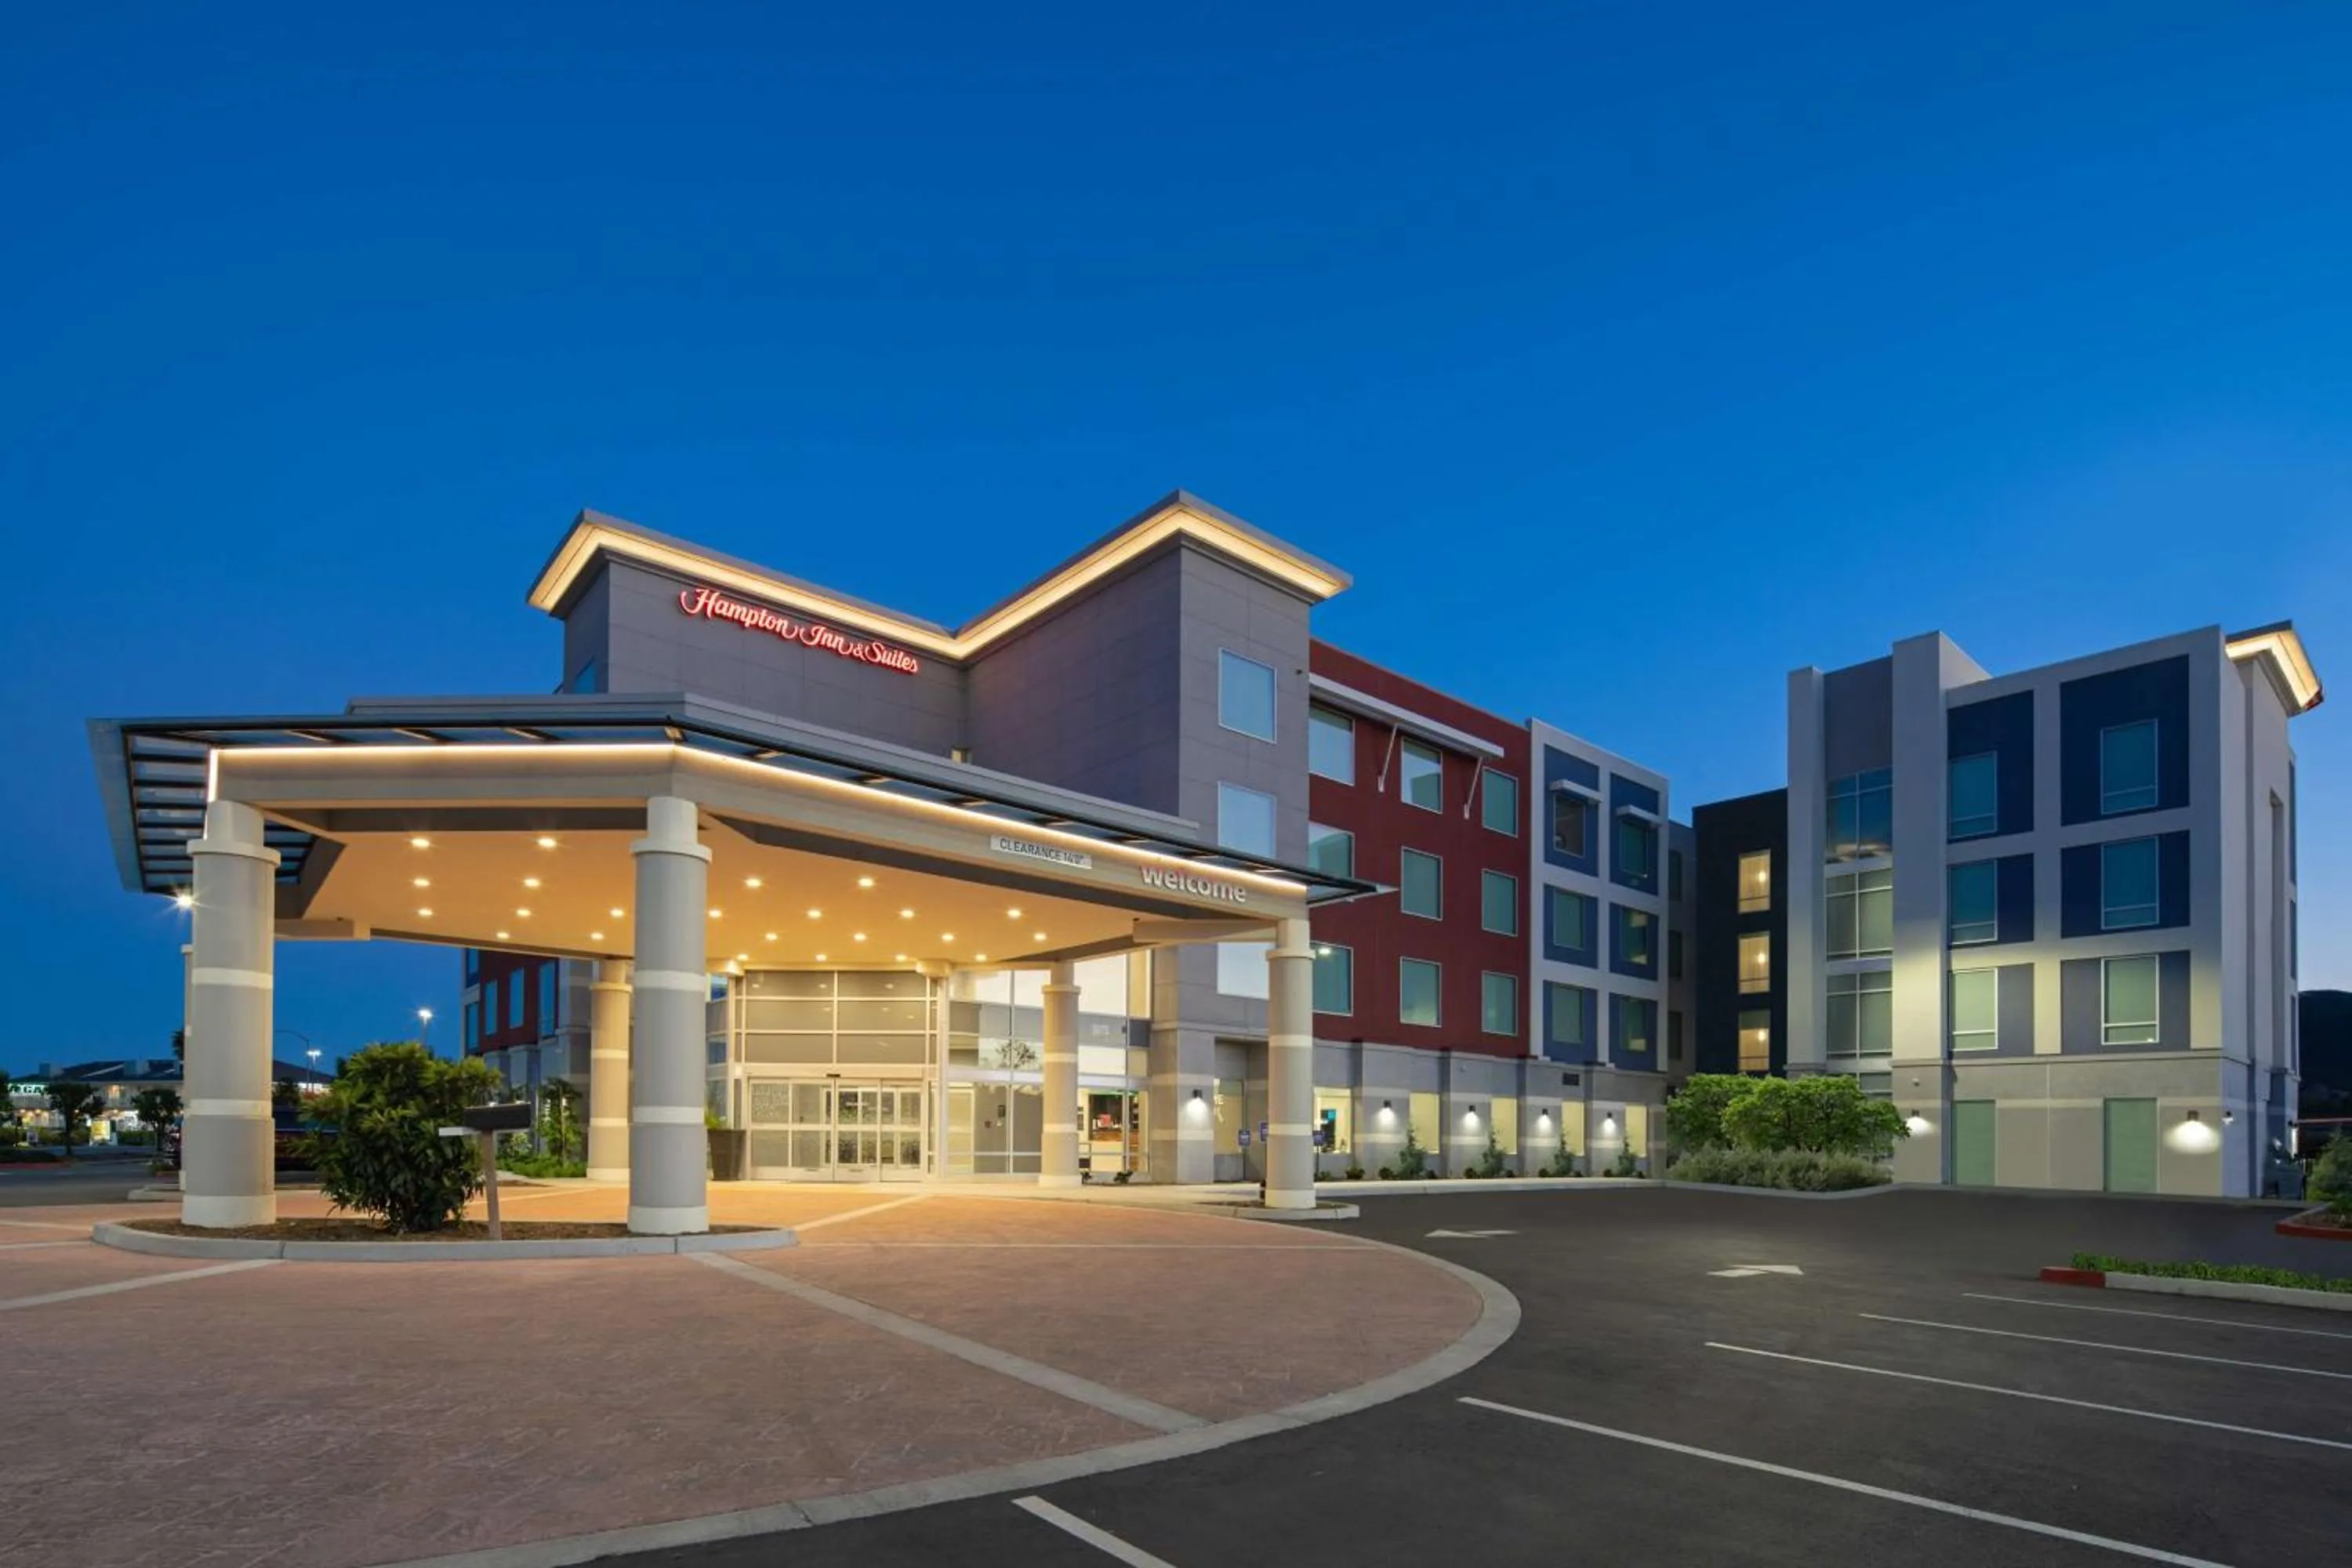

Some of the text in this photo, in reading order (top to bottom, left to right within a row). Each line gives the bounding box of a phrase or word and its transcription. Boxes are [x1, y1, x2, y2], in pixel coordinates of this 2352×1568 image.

[681, 588, 918, 673] Hampton Inn & Suites
[1000, 838, 1062, 861] CLEARANCE
[1140, 865, 1247, 902] welcome
